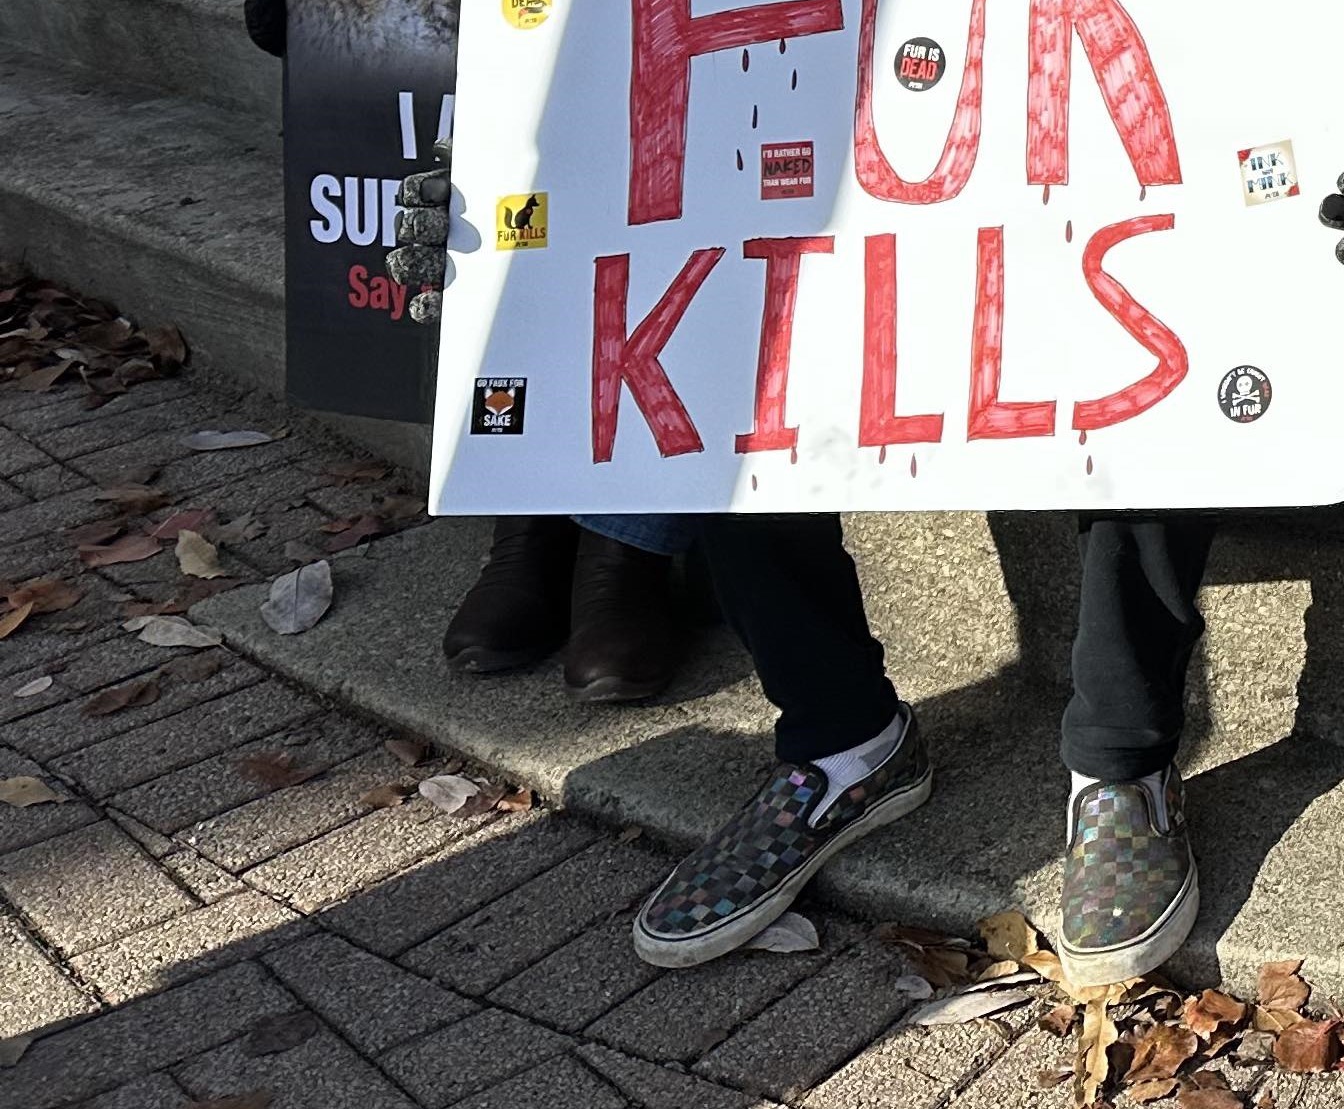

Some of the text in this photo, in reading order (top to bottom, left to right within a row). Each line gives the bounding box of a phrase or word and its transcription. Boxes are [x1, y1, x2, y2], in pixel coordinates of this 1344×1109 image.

[903, 43, 941, 62] FUR IS
[900, 57, 938, 80] DEAD
[763, 158, 812, 178] NAKED
[1249, 151, 1284, 171] INK
[1246, 172, 1296, 194] MINK
[497, 227, 546, 242] FUR KILLS
[348, 264, 407, 321] Say
[592, 213, 1189, 464] KILLS
[483, 414, 512, 427] SAKE
[1229, 403, 1262, 418] IN FUR
